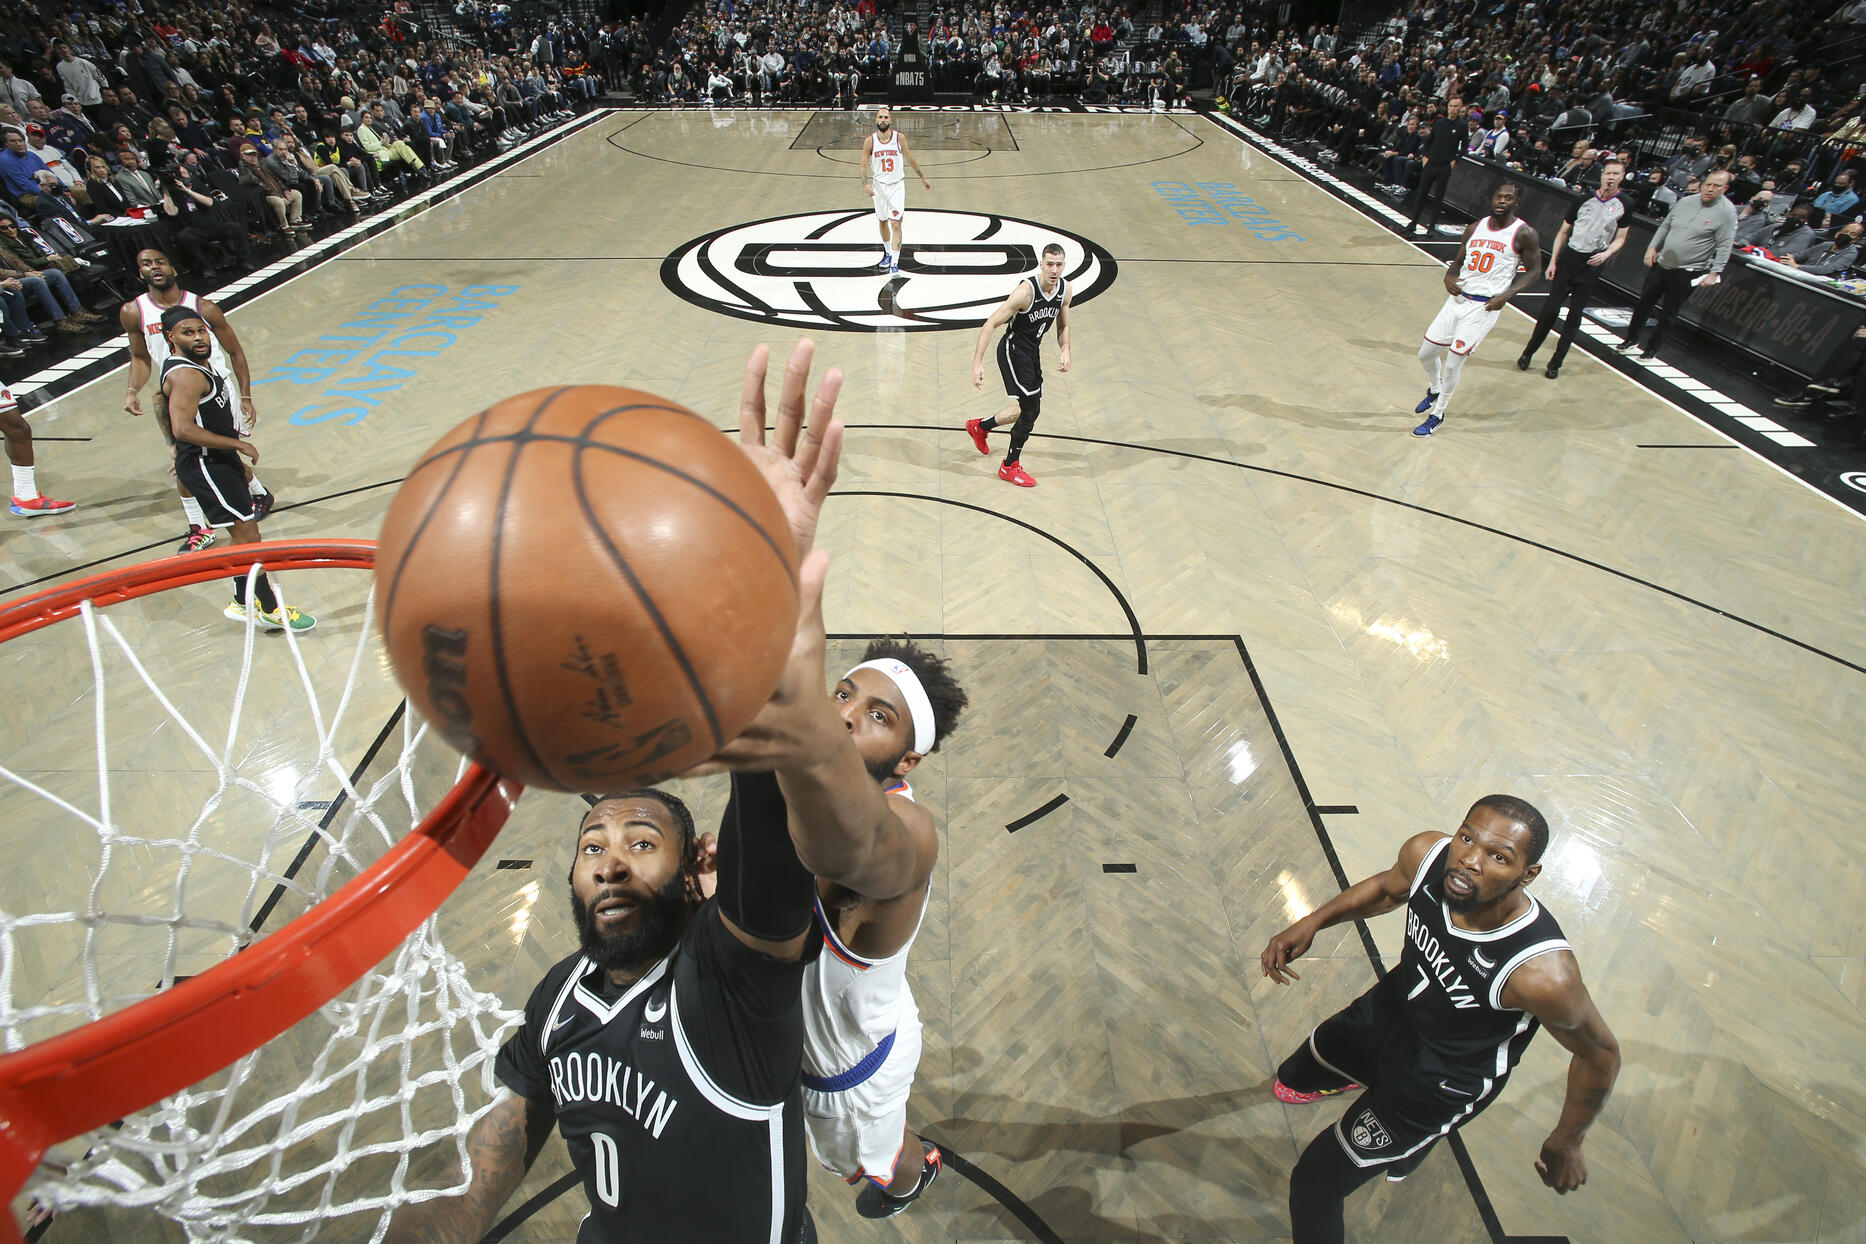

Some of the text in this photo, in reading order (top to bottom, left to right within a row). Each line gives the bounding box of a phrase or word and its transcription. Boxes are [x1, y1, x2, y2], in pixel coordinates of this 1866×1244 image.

[896, 72, 924, 85] #NBA75
[857, 104, 1072, 113] Brooklyn
[874, 150, 885, 158] NEW
[881, 158, 894, 172] 13
[1149, 181, 1230, 226] CENTER
[1195, 182, 1306, 242] BARCLAYS
[1469, 239, 1508, 254] NEW YORK
[1467, 251, 1495, 273] 30
[146, 322, 162, 335] NE
[249, 284, 449, 386] CENTER
[1036, 322, 1047, 338] 9
[289, 284, 522, 426] BARCLAYS
[1407, 907, 1480, 1009] BROOKLYN
[1467, 957, 1488, 979] Webull
[1407, 963, 1430, 1001] 7
[640, 1028, 664, 1041] Webull
[1355, 1131, 1368, 1142] B
[1360, 1111, 1389, 1146] NETS
[590, 1132, 619, 1208] 0
